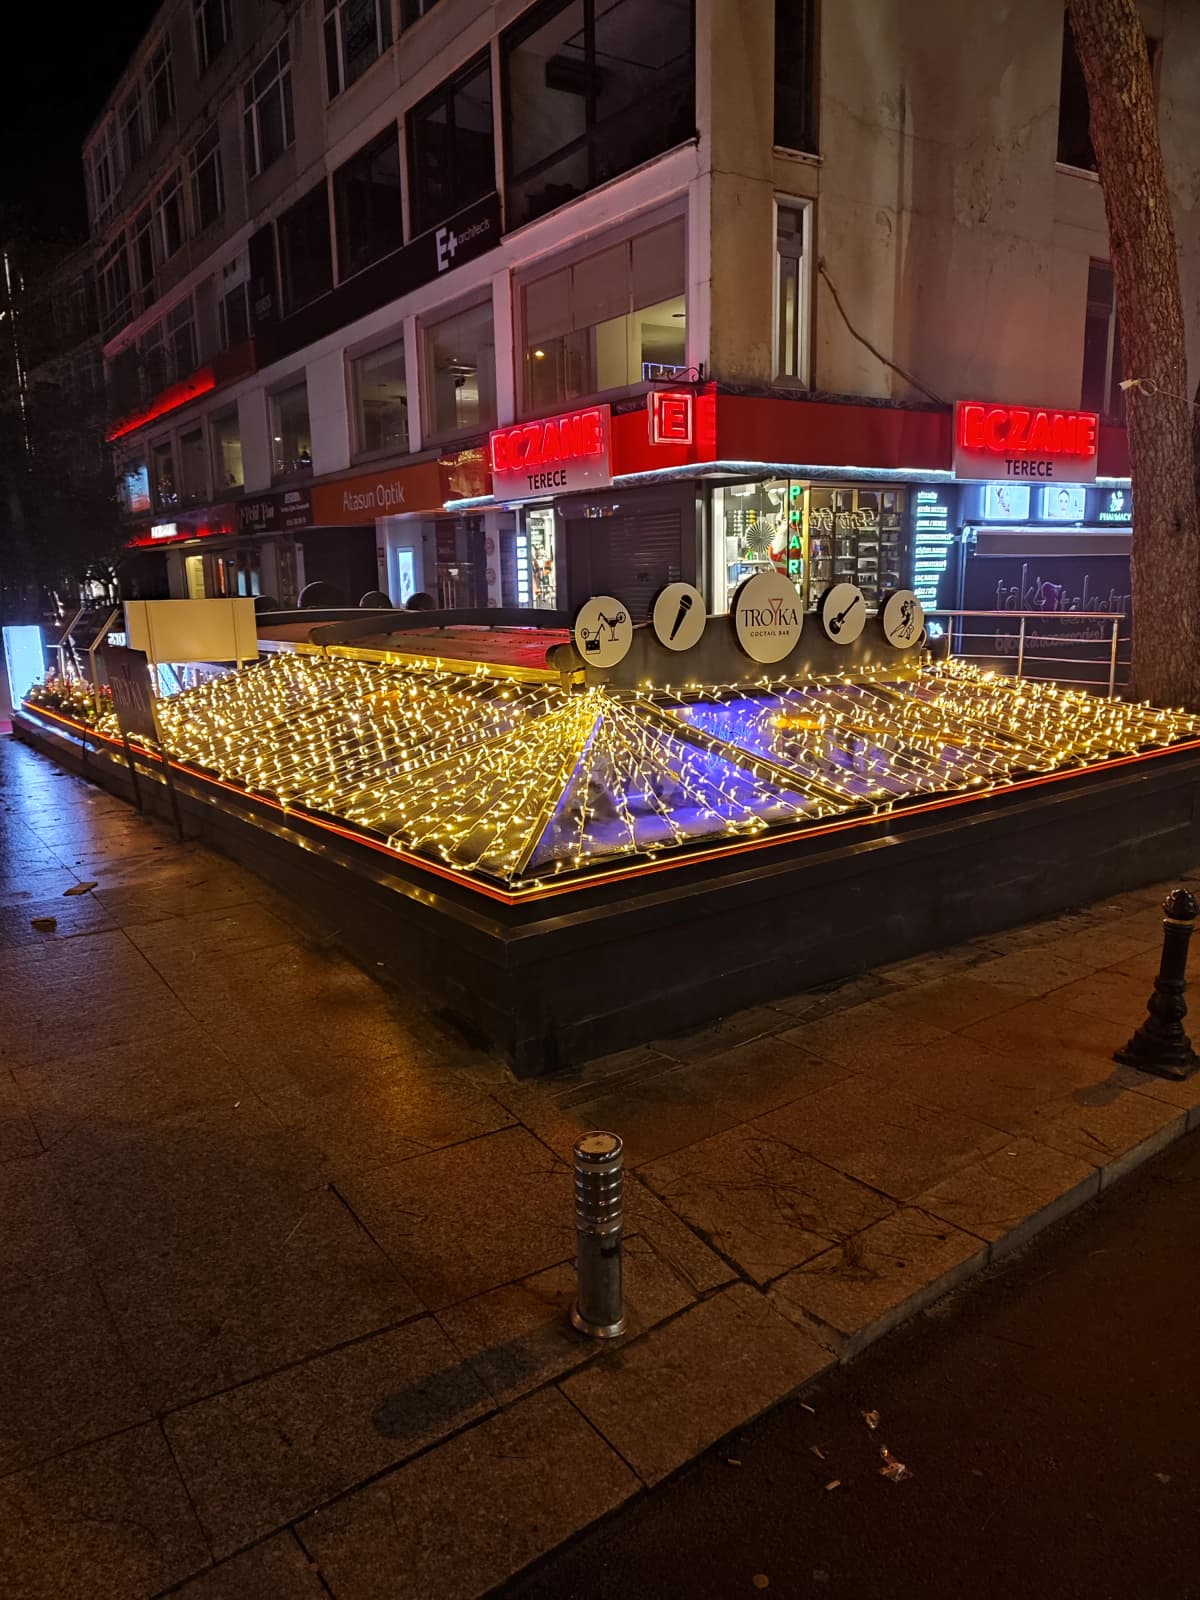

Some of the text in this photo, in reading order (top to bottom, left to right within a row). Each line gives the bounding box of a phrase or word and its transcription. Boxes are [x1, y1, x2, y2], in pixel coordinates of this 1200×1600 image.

[661, 400, 686, 438] E
[961, 405, 1096, 455] ECZANE
[492, 410, 605, 472] ECZANE
[527, 469, 567, 490] TERECE
[1005, 459, 1053, 477] TERECE
[343, 480, 405, 512] Atasun Optik
[741, 598, 799, 628] TROYKA
[750, 630, 777, 638] COCTAIL
